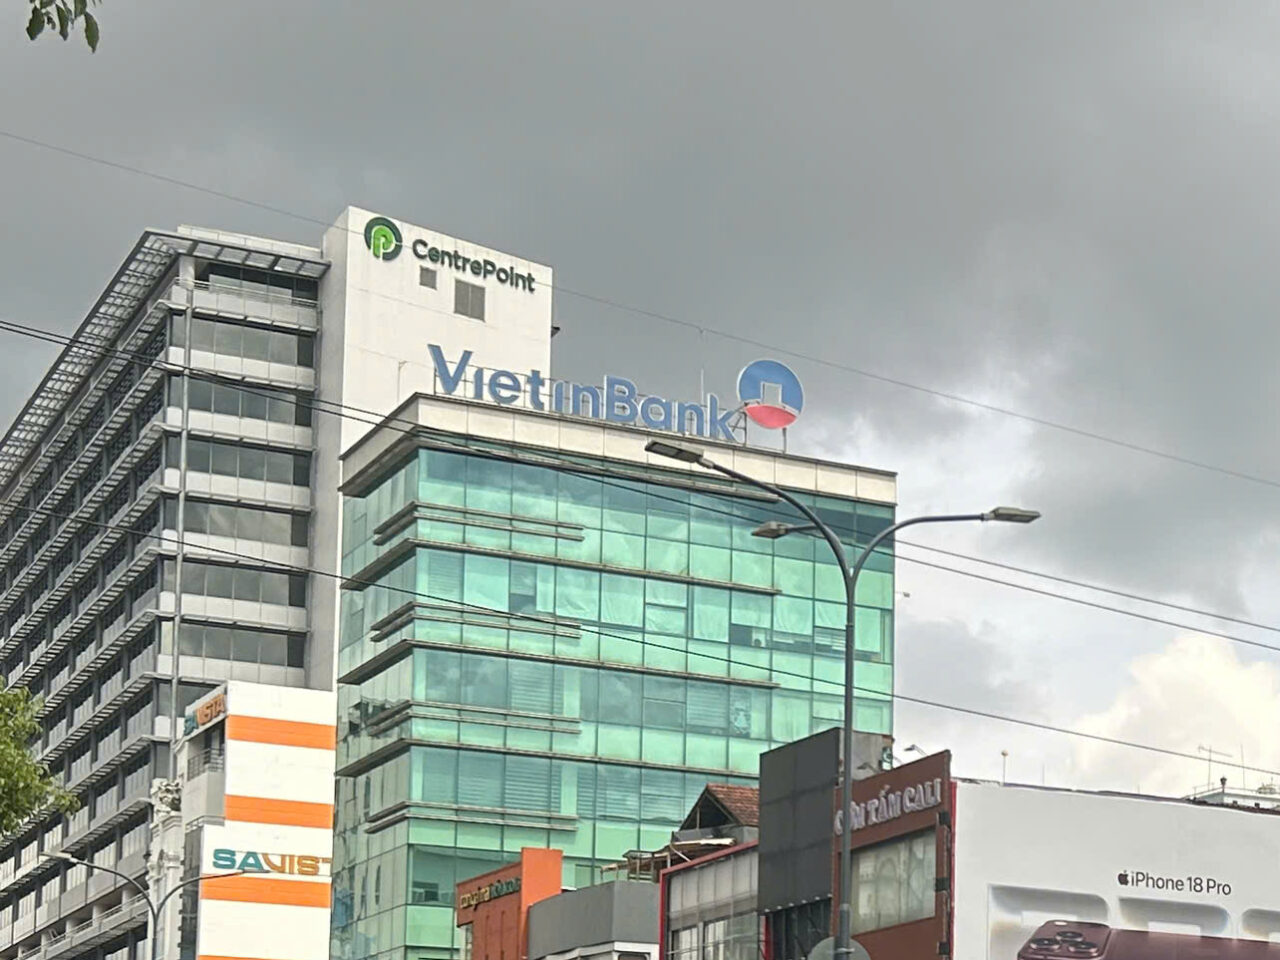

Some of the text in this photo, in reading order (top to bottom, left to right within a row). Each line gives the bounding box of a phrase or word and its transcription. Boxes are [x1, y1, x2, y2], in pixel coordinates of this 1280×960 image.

[412, 238, 536, 293] CentrePoint
[427, 343, 738, 444] VietinBank
[834, 801, 866, 836] CM
[903, 778, 942, 814] CALI
[1131, 871, 1232, 896] iPhone 18 Pro
